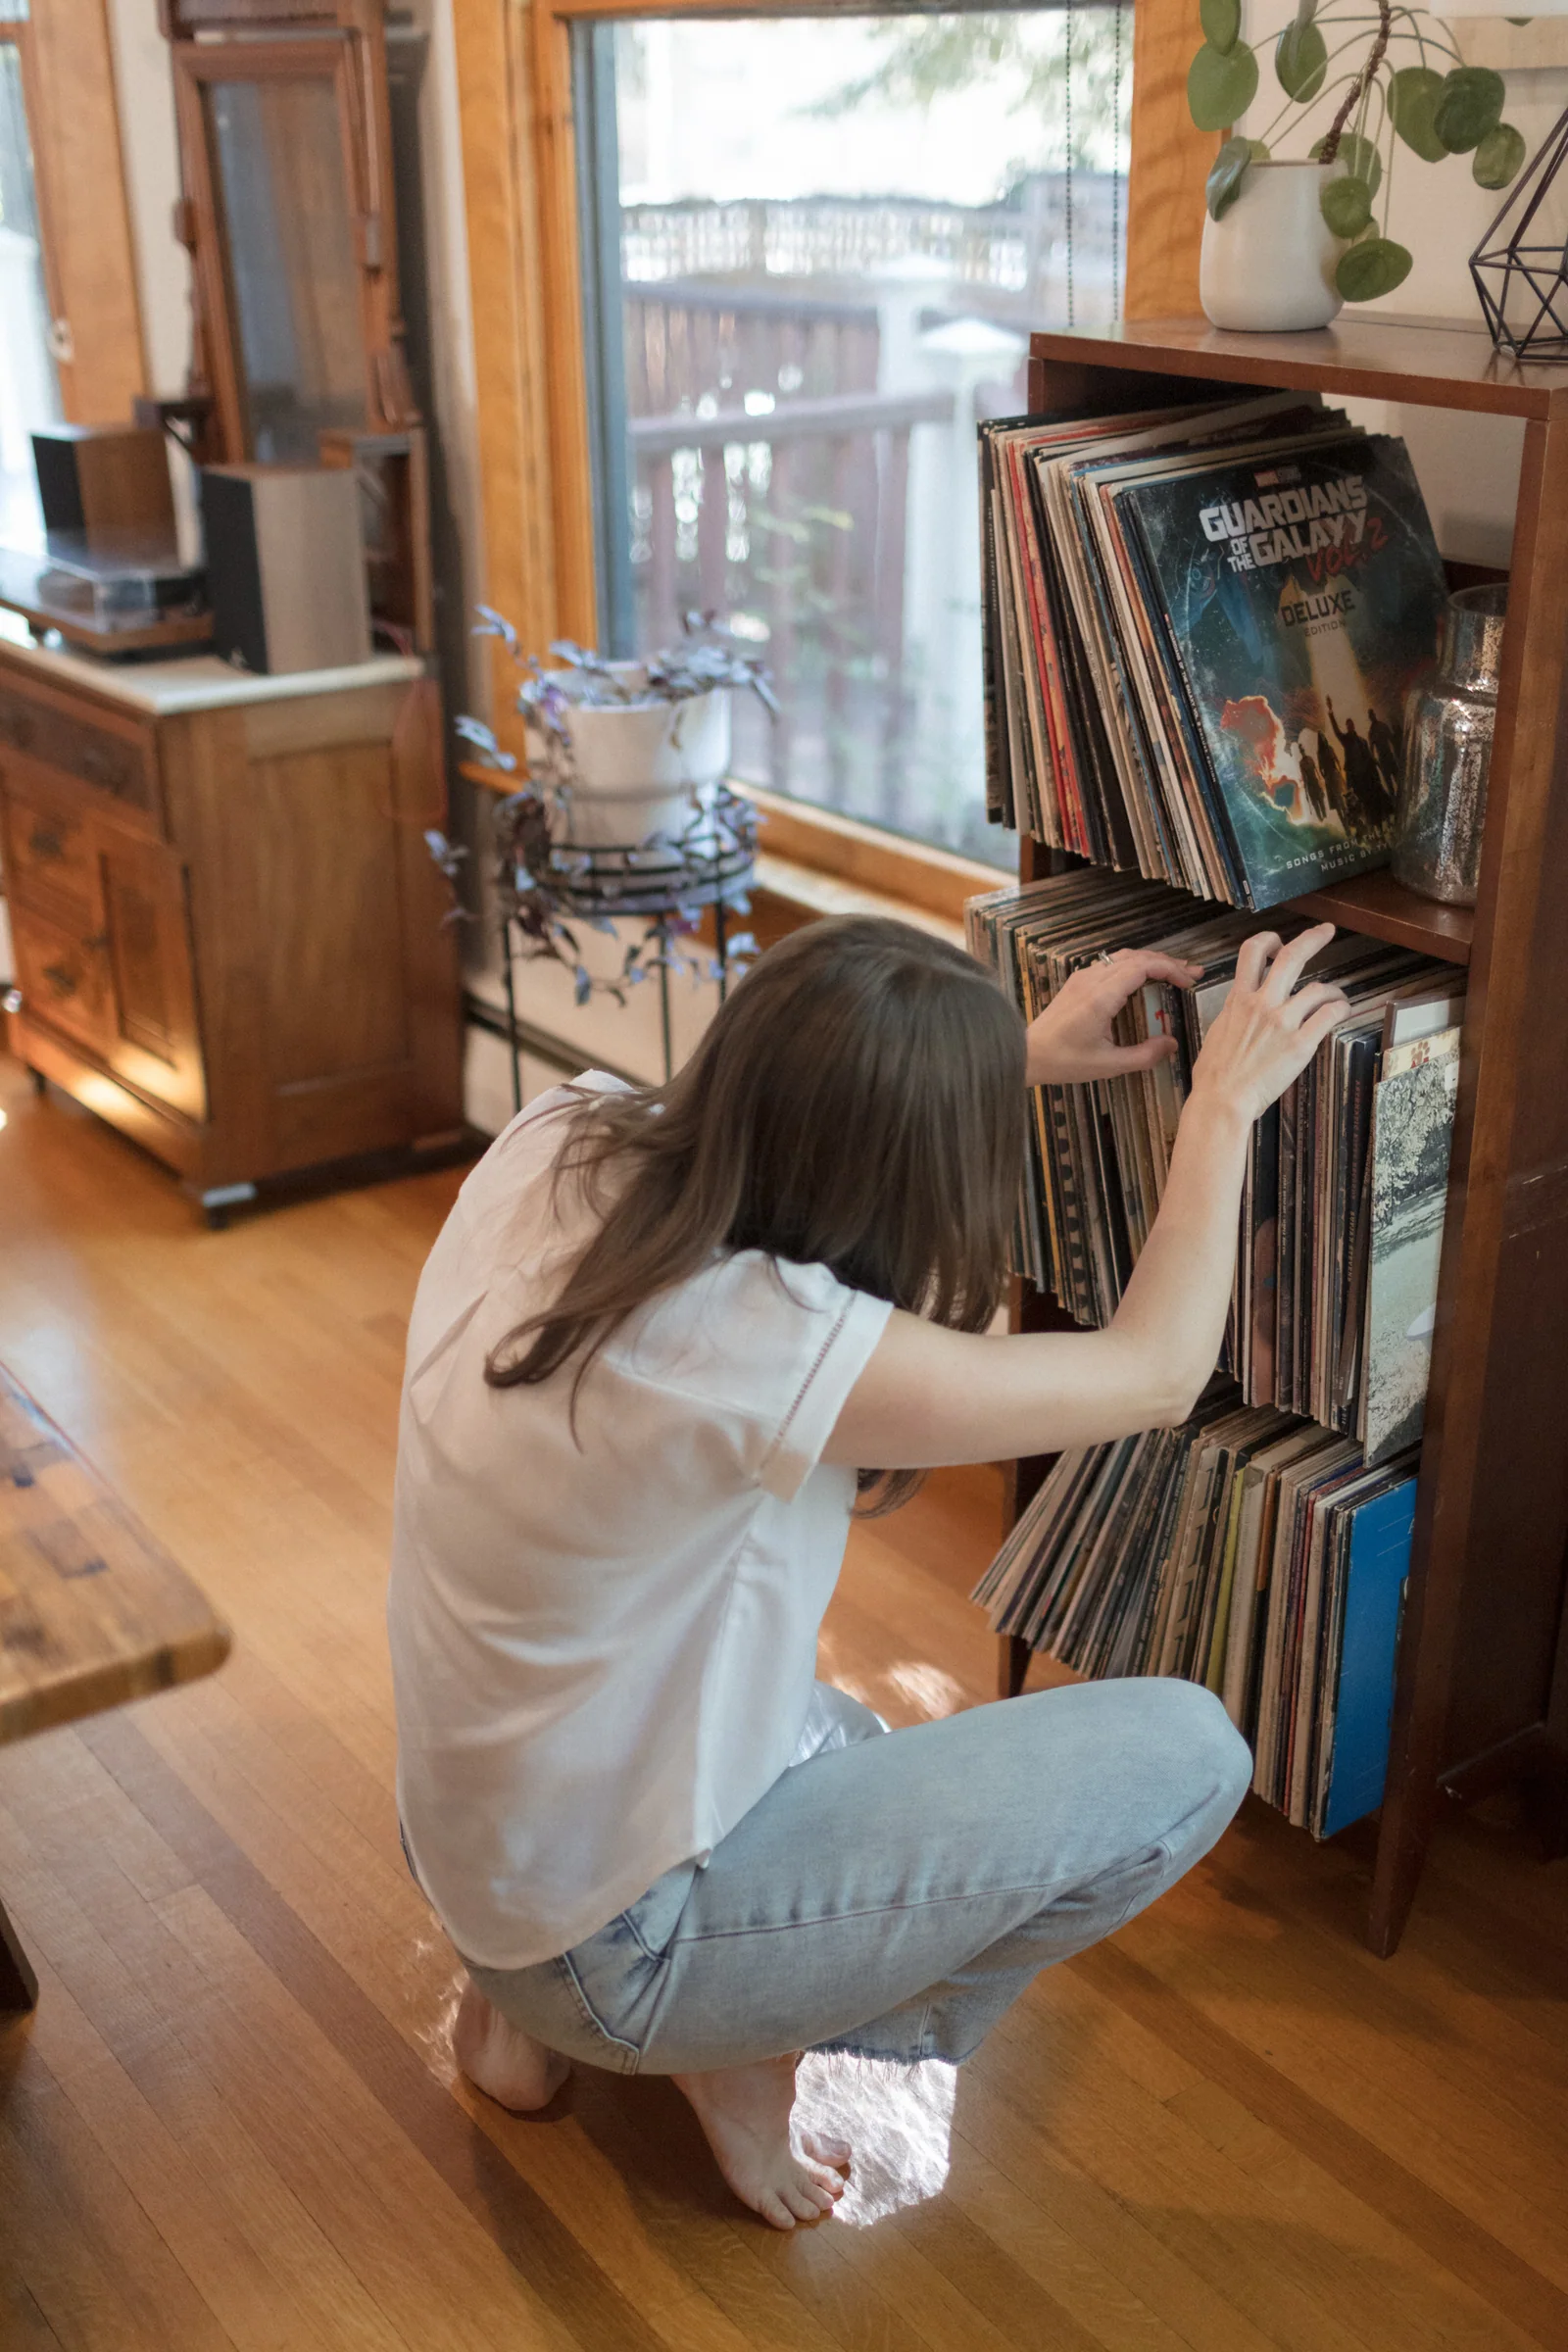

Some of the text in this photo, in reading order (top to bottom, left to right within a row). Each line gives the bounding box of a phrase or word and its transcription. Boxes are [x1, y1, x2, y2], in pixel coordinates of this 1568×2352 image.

[1200, 475, 1368, 542] GUARDIANS
[1231, 537, 1249, 556] OF
[1249, 510, 1367, 565] GALAXY
[1227, 555, 1255, 573] THE
[1281, 591, 1355, 627] DELUXE
[1304, 619, 1348, 637] EDITION
[1169, 629, 1181, 661] GUARDIANS
[1186, 684, 1195, 707] GALAXY
[1286, 850, 1325, 870] SONGS
[1329, 840, 1358, 855] FROM
[1321, 854, 1355, 872] MUSIC
[1360, 849, 1373, 858] BY
